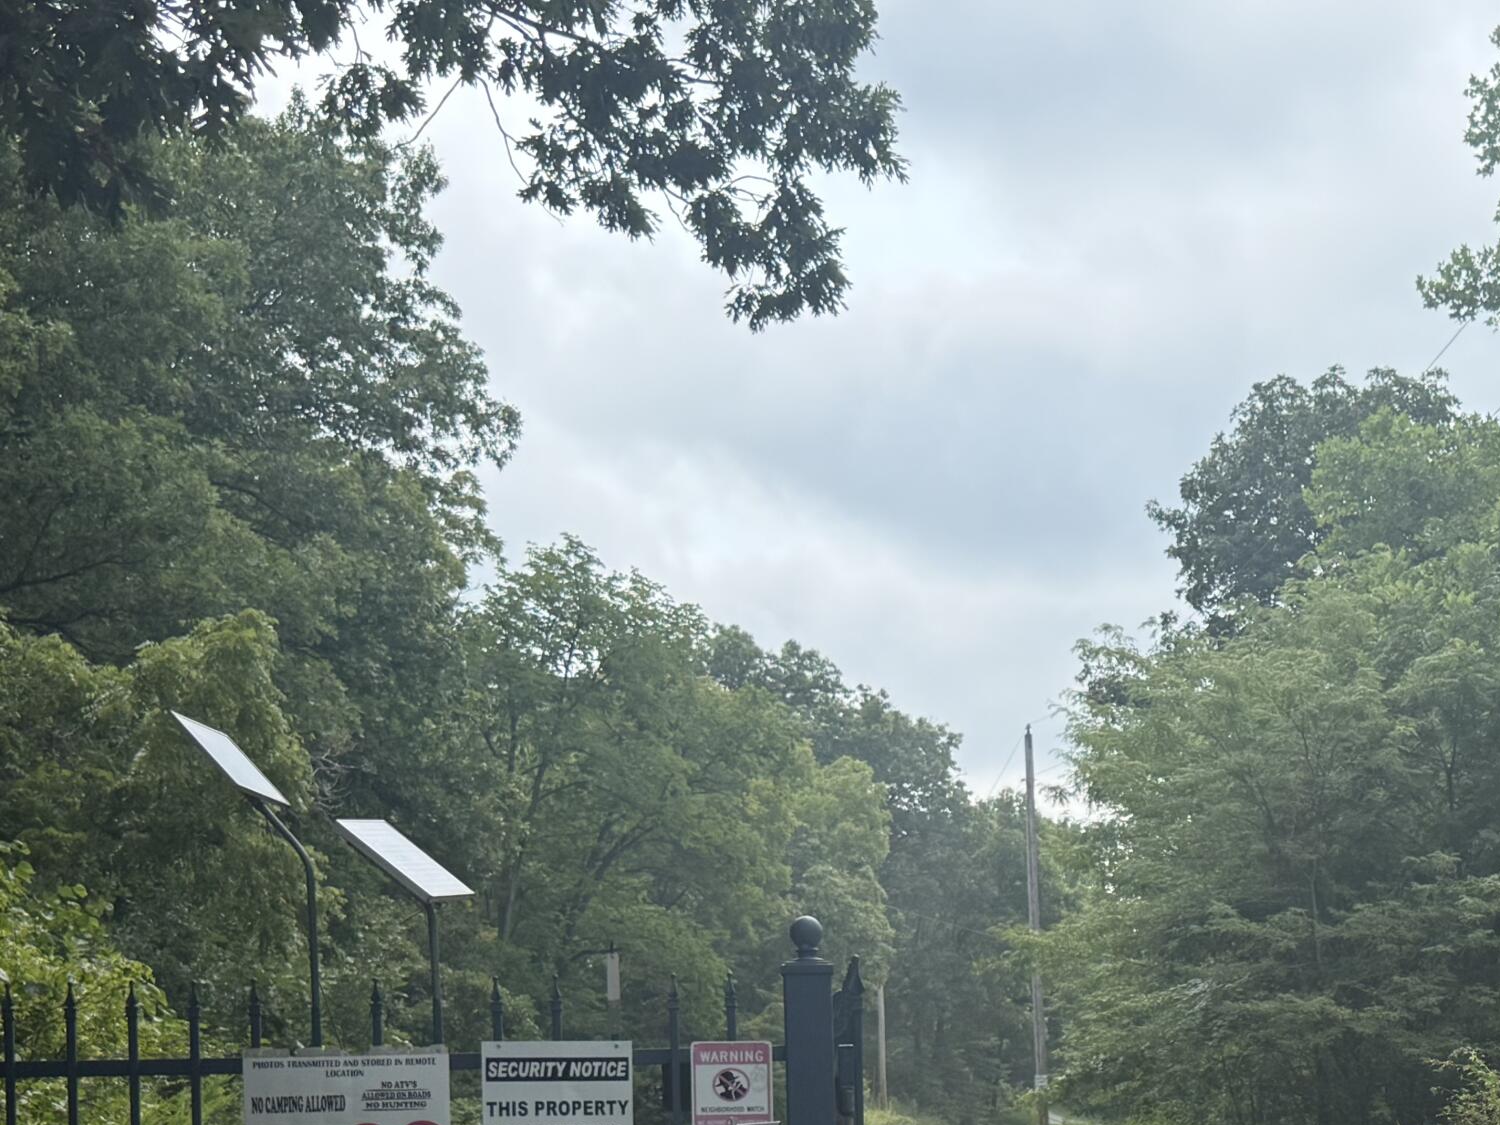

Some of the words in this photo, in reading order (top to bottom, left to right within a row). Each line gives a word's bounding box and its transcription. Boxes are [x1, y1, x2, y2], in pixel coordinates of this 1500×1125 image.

[700, 1050, 764, 1063] WARNING
[252, 1060, 285, 1070] PHOTOS
[287, 1060, 340, 1069] TRANSMITTED
[361, 1058, 393, 1067] STORED
[394, 1058, 403, 1066] IN
[405, 1057, 437, 1066] REMOTE
[488, 1061, 567, 1078] SECURITY
[569, 1060, 628, 1077] NOTICE
[325, 1069, 365, 1078] LOCATION
[381, 1081, 393, 1089] NO
[362, 1091, 395, 1100] ALLOWED
[396, 1091, 407, 1100] ON
[408, 1091, 432, 1099] ROADS
[251, 1096, 264, 1115] NO
[265, 1095, 304, 1114] CAMPING
[305, 1094, 346, 1113] ALLOWED
[366, 1101, 380, 1109] NO
[382, 1100, 427, 1109] HUNTING
[486, 1101, 529, 1117] THIS
[535, 1100, 629, 1117] PROPERTY
